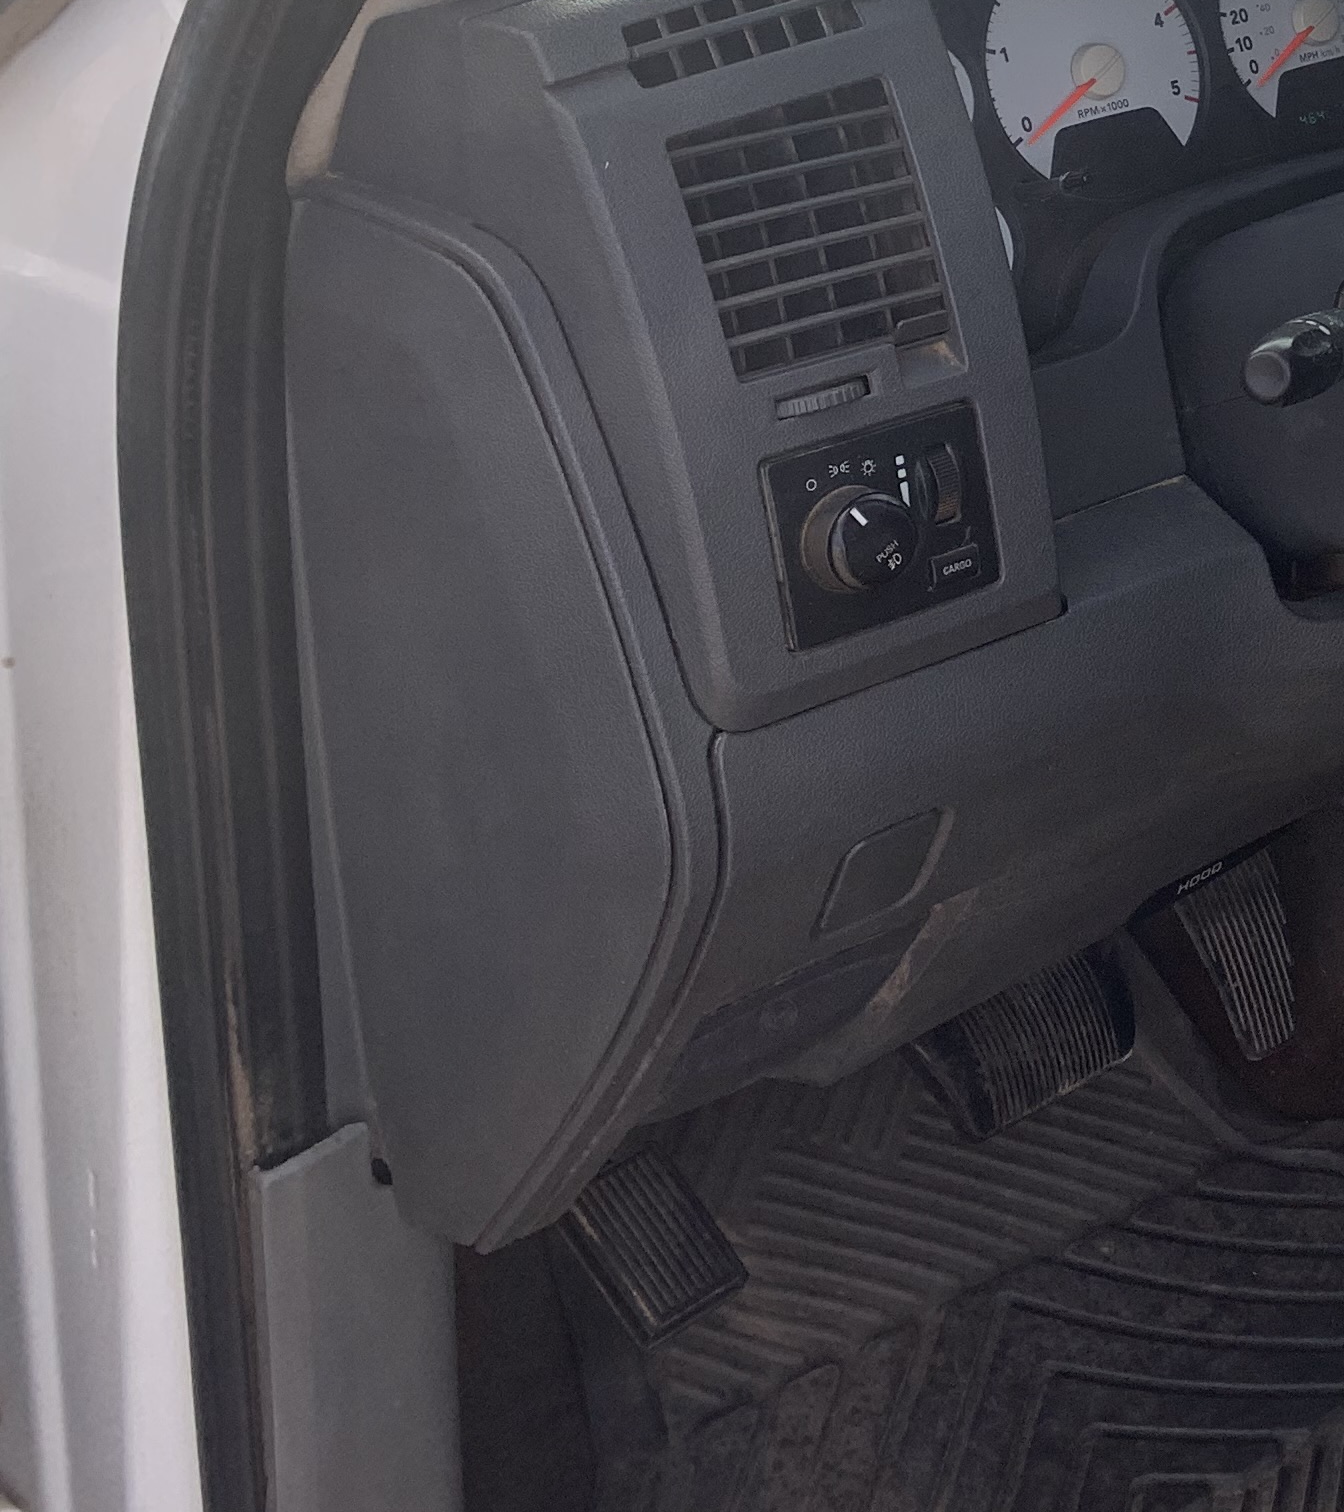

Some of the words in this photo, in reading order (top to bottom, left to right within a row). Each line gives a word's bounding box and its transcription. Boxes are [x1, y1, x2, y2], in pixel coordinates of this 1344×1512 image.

[1154, 12, 1165, 28] 4
[1229, 7, 1249, 25] 20
[1235, 35, 1254, 52] 10
[999, 46, 1010, 63] 1
[1299, 50, 1319, 62] MPH
[1249, 59, 1259, 75] 0
[1170, 79, 1181, 96] 5
[1077, 104, 1100, 119] RPM
[1020, 115, 1033, 134] 0
[875, 539, 899, 563] PUSH
[942, 558, 972, 576] CARGO
[1177, 861, 1222, 895] HOOD
